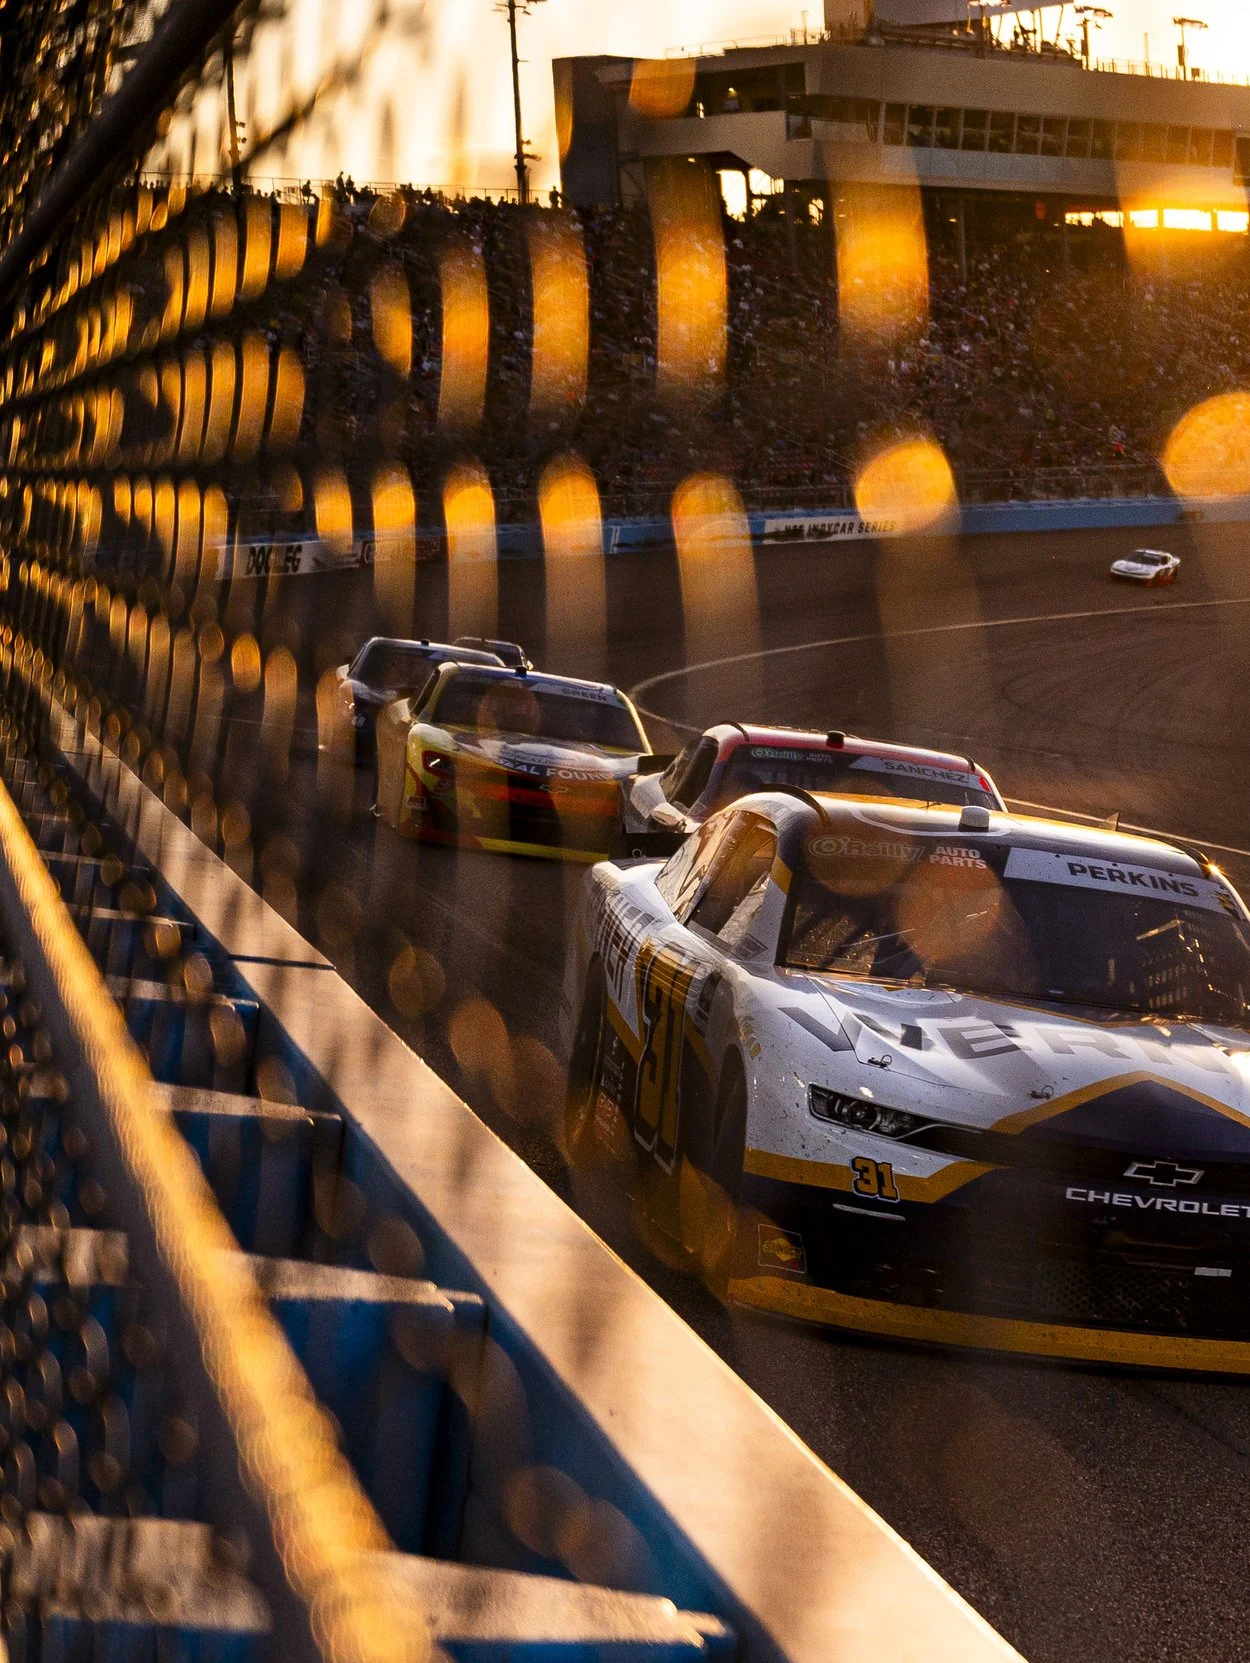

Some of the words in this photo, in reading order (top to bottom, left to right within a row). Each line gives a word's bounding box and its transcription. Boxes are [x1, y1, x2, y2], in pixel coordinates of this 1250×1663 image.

[857, 520, 896, 535] SERIES
[884, 761, 968, 784] SANCHEZ
[929, 854, 988, 869] PARTS
[935, 845, 981, 859] AUTO
[1067, 862, 1200, 897] PERKINS
[851, 1156, 900, 1203] 31
